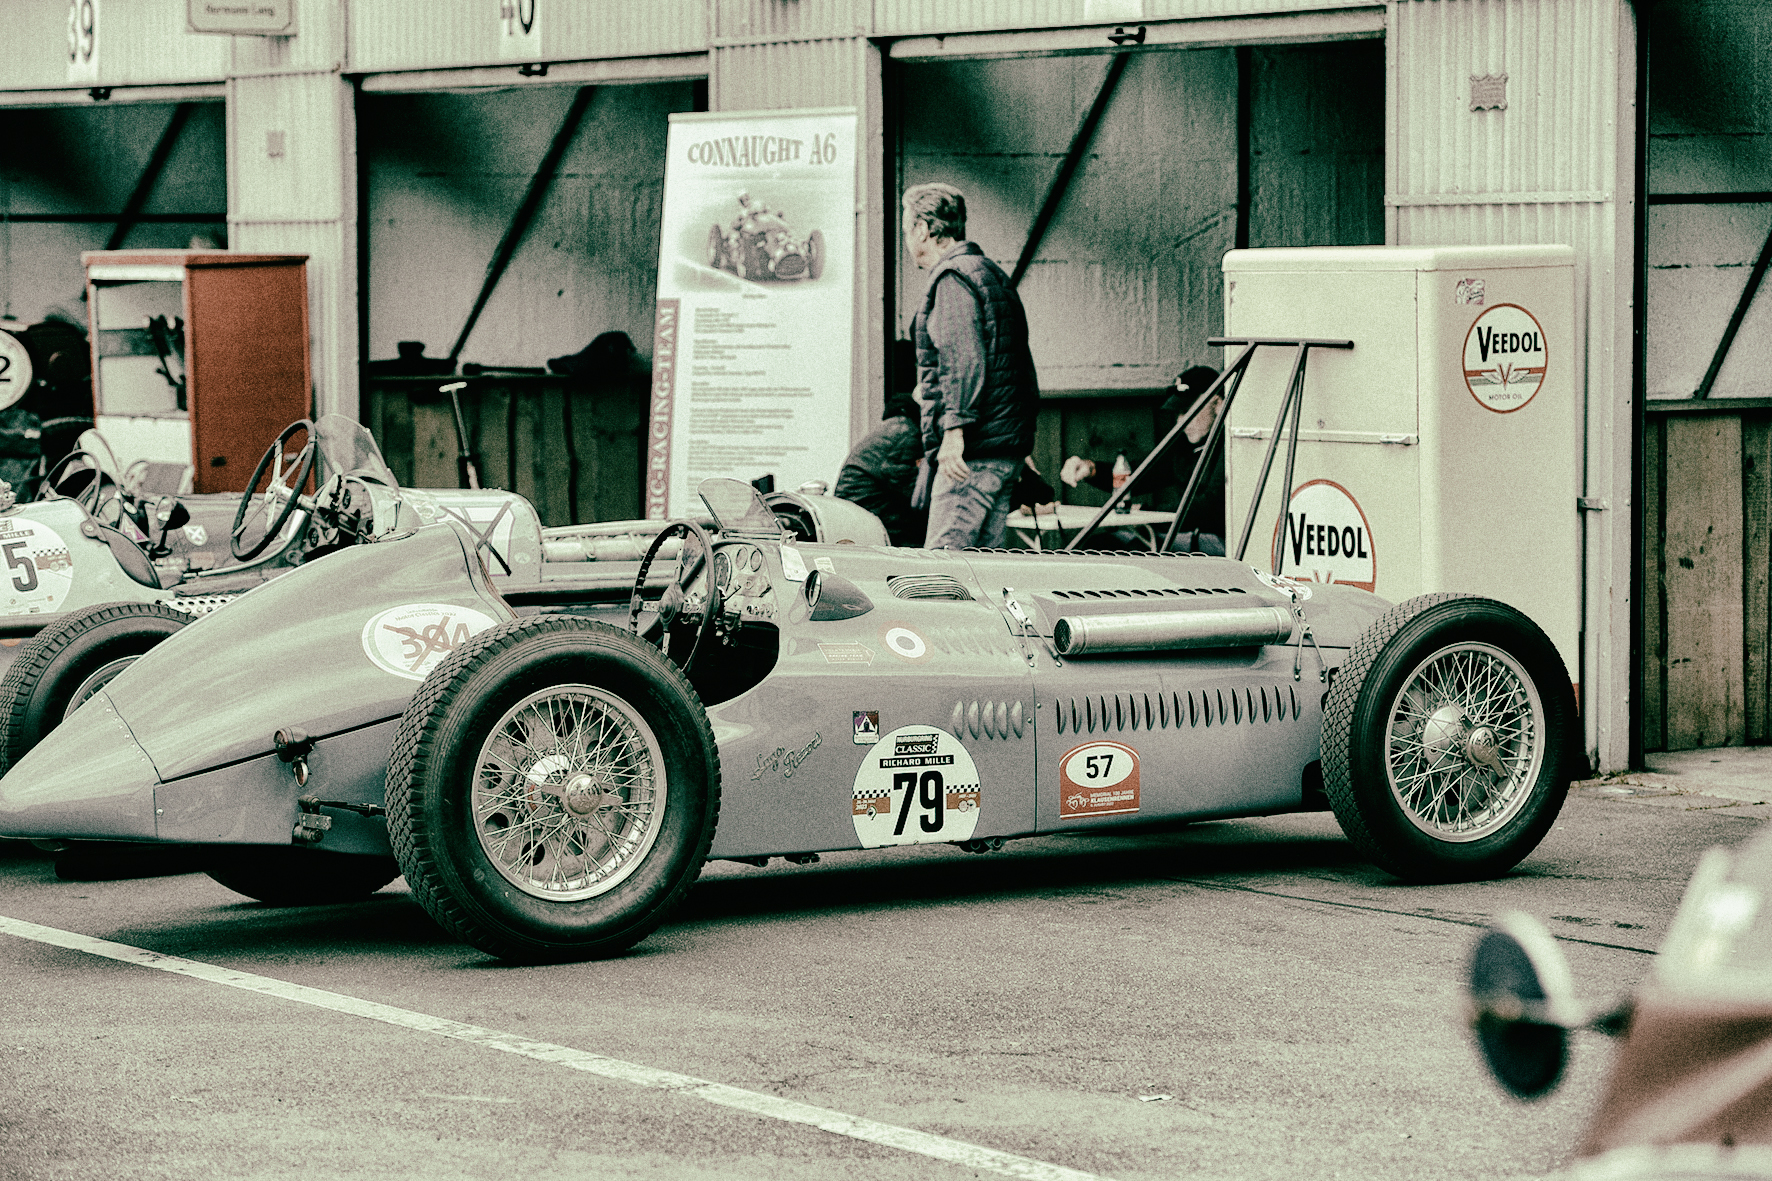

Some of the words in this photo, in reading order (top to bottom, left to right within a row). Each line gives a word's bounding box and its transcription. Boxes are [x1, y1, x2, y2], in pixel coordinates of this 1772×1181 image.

[687, 135, 804, 167] CONNAUGHT
[809, 133, 837, 165] A6
[1477, 326, 1542, 362] VEEDOL
[1289, 512, 1367, 566] VEEDOL
[882, 758, 921, 767] RICHARD
[924, 756, 951, 765] MILLE
[895, 744, 932, 754] CLASSIC
[1086, 754, 1113, 778] 57
[893, 770, 944, 836] 79
